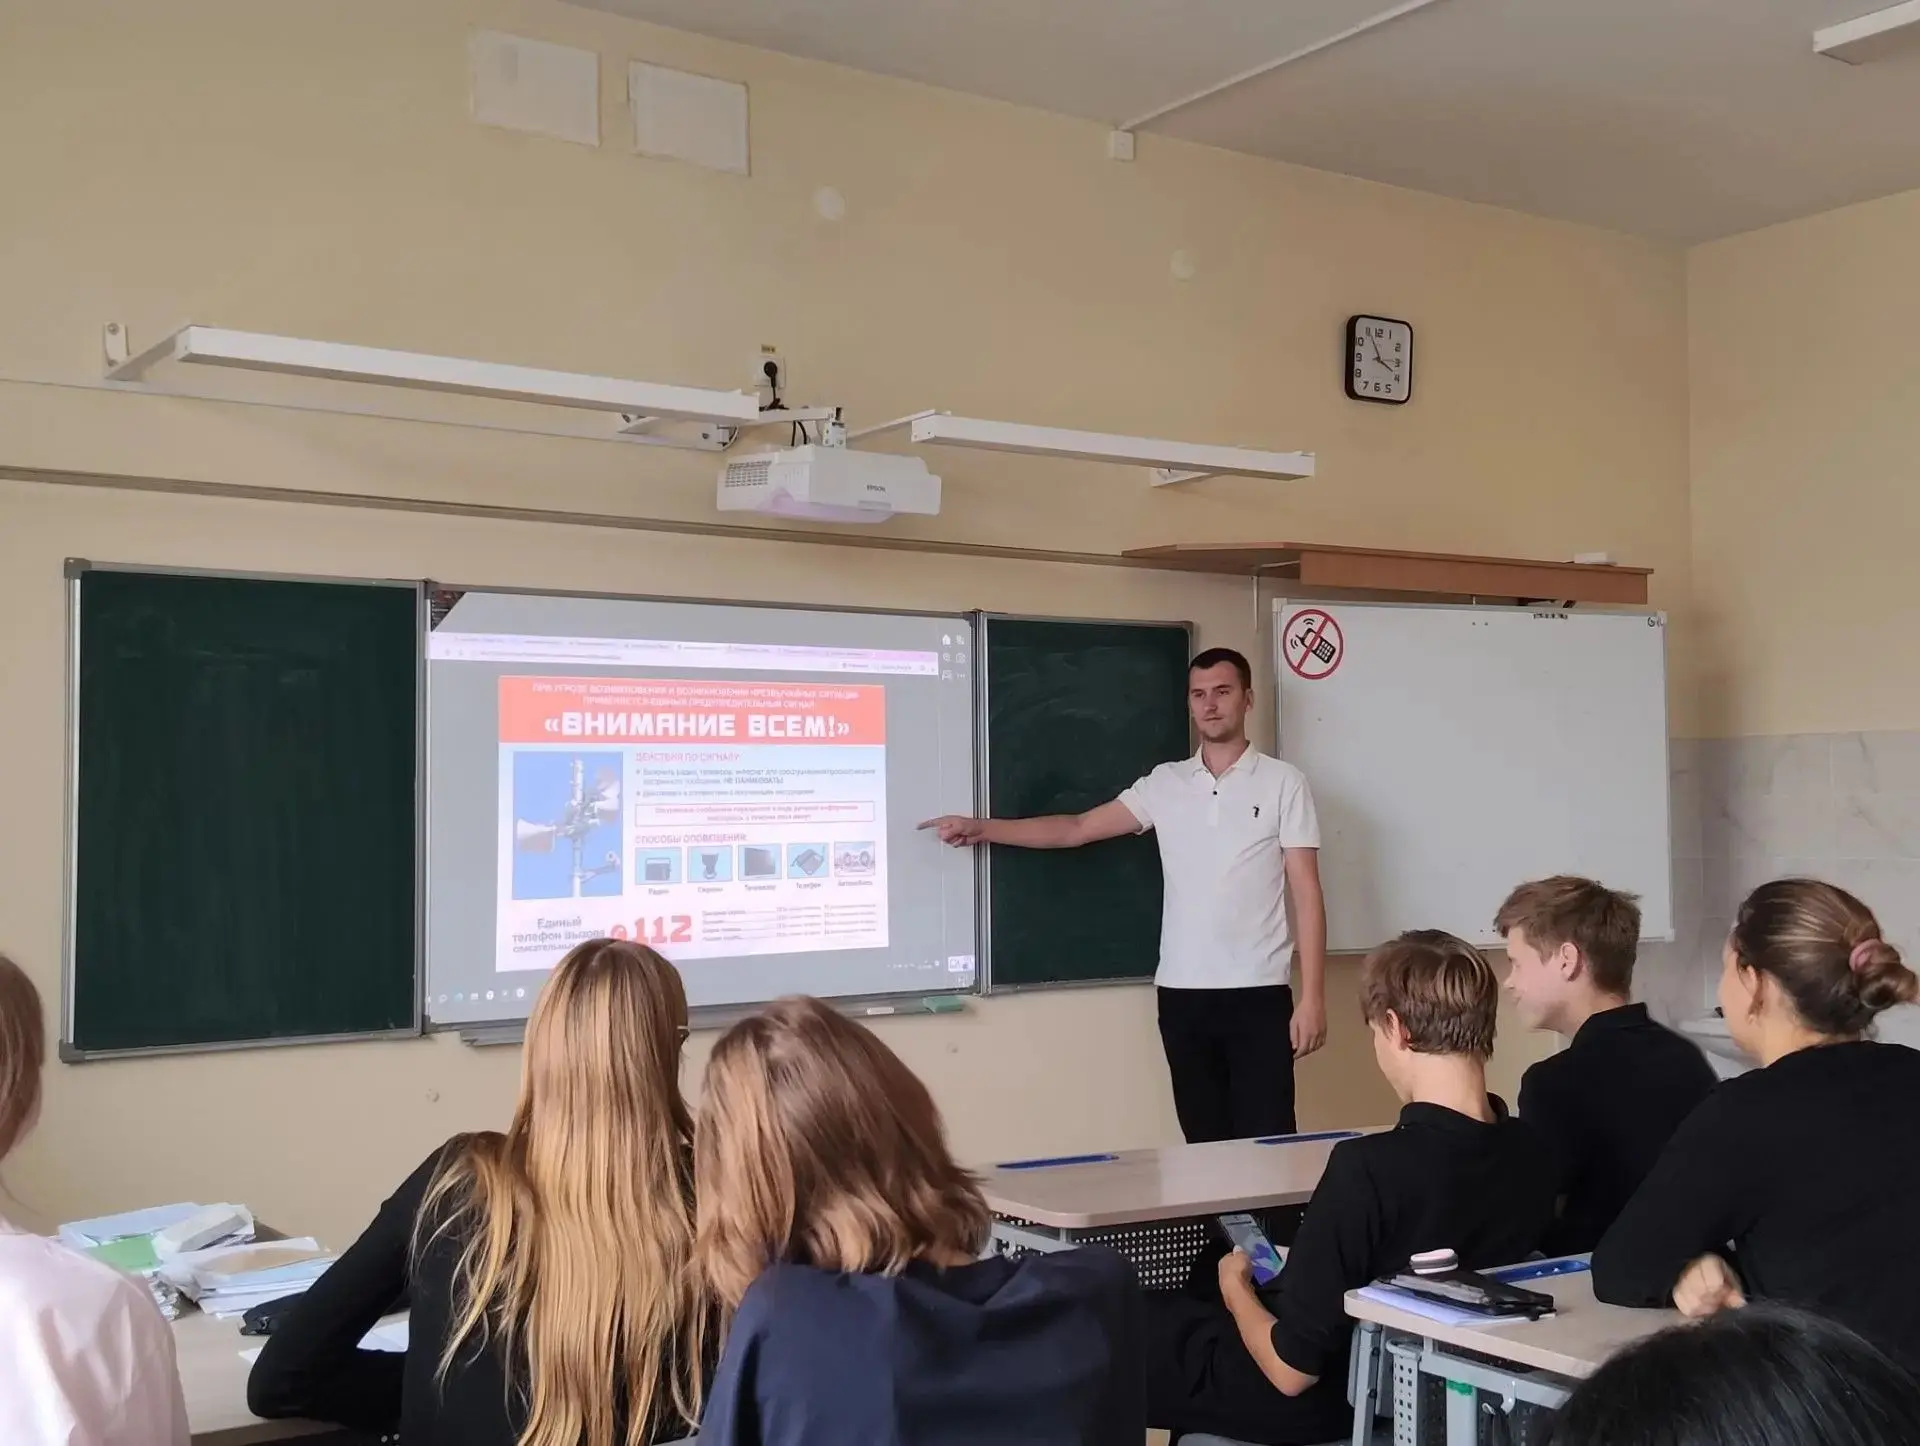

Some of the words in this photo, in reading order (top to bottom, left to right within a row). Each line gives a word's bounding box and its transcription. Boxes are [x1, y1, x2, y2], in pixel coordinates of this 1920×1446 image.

[1375, 328, 1383, 338] 12
[1356, 337, 1364, 346] 10
[1395, 343, 1401, 352] 2
[1356, 353, 1362, 362] 9
[1394, 358, 1400, 368] 3
[1355, 369, 1361, 378] 8
[1394, 374, 1400, 384] 4
[1363, 381, 1369, 390] 7
[1374, 382, 1380, 392] 6
[1385, 384, 1392, 393] 5
[544, 711, 736, 737] «ВНИМАНИЕ
[748, 714, 850, 738] ВСЕМ!»
[537, 916, 582, 930] Единый
[633, 915, 692, 944] 112
[512, 931, 562, 943] телефон
